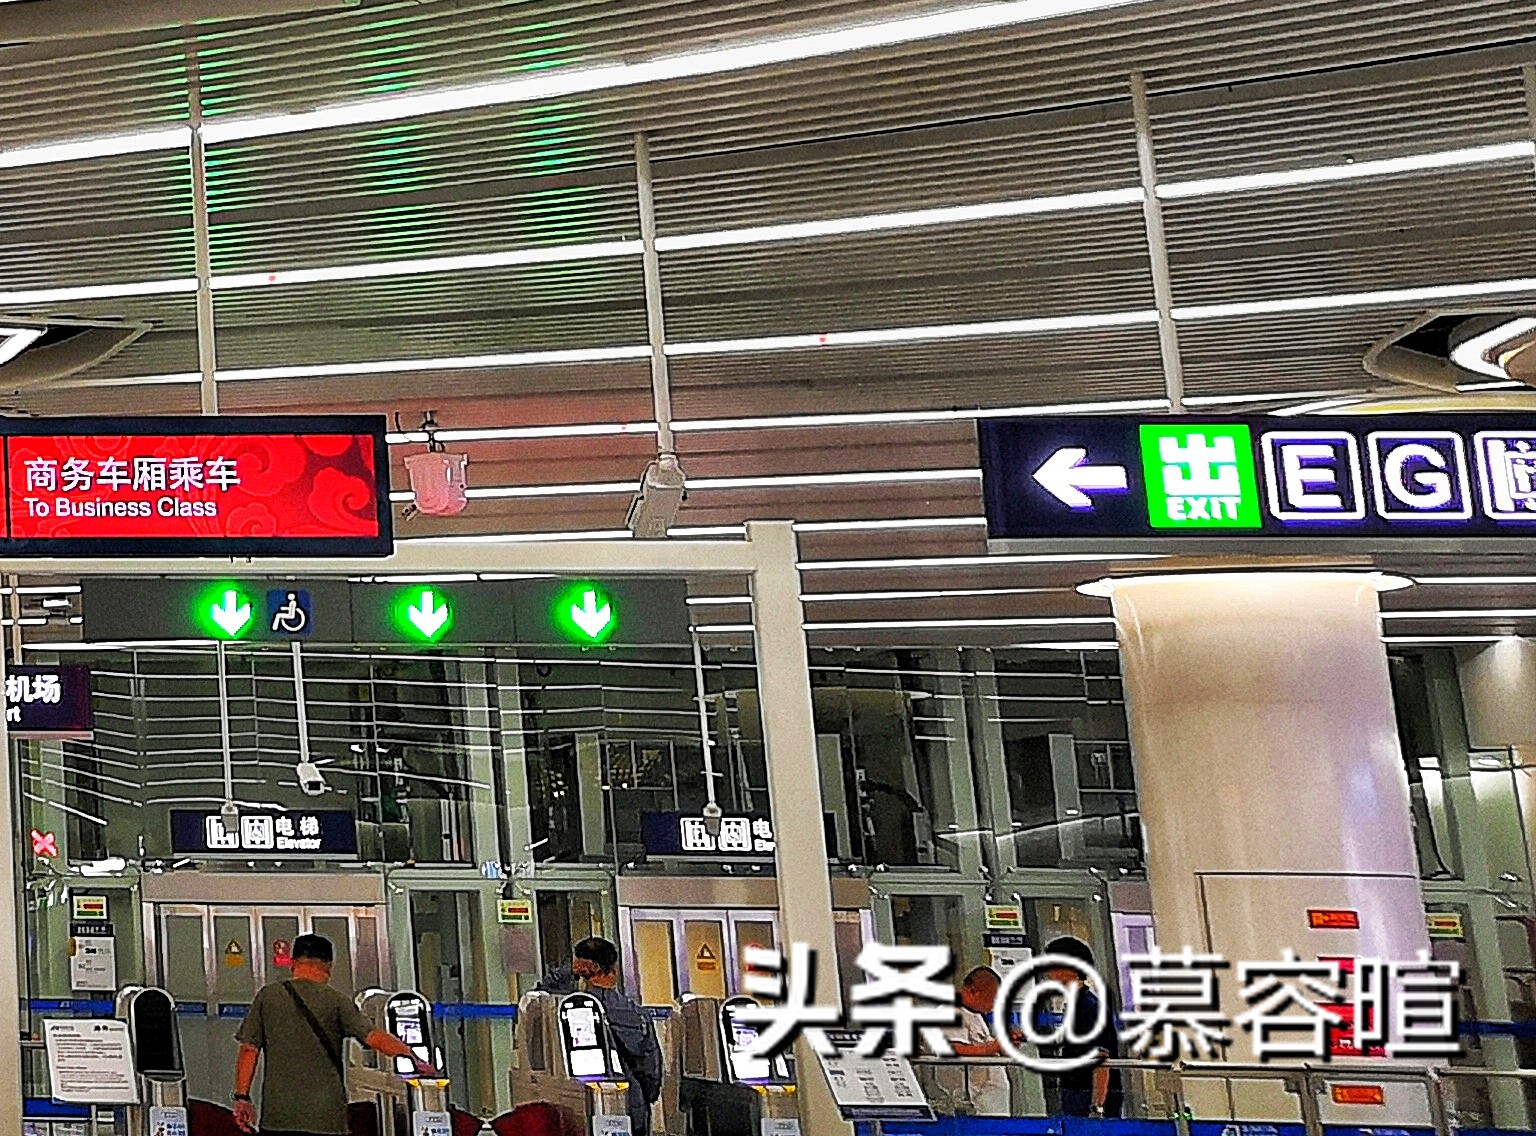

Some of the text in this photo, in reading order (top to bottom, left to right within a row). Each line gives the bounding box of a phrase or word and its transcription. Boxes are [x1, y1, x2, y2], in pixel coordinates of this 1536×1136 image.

[24, 456, 240, 491] 商务车厢乘车
[1159, 434, 1240, 495] 出
[1282, 444, 1453, 508] E G
[24, 497, 217, 517] To Business Class
[1167, 497, 1240, 519] EXIT
[277, 837, 321, 849] Elevator
